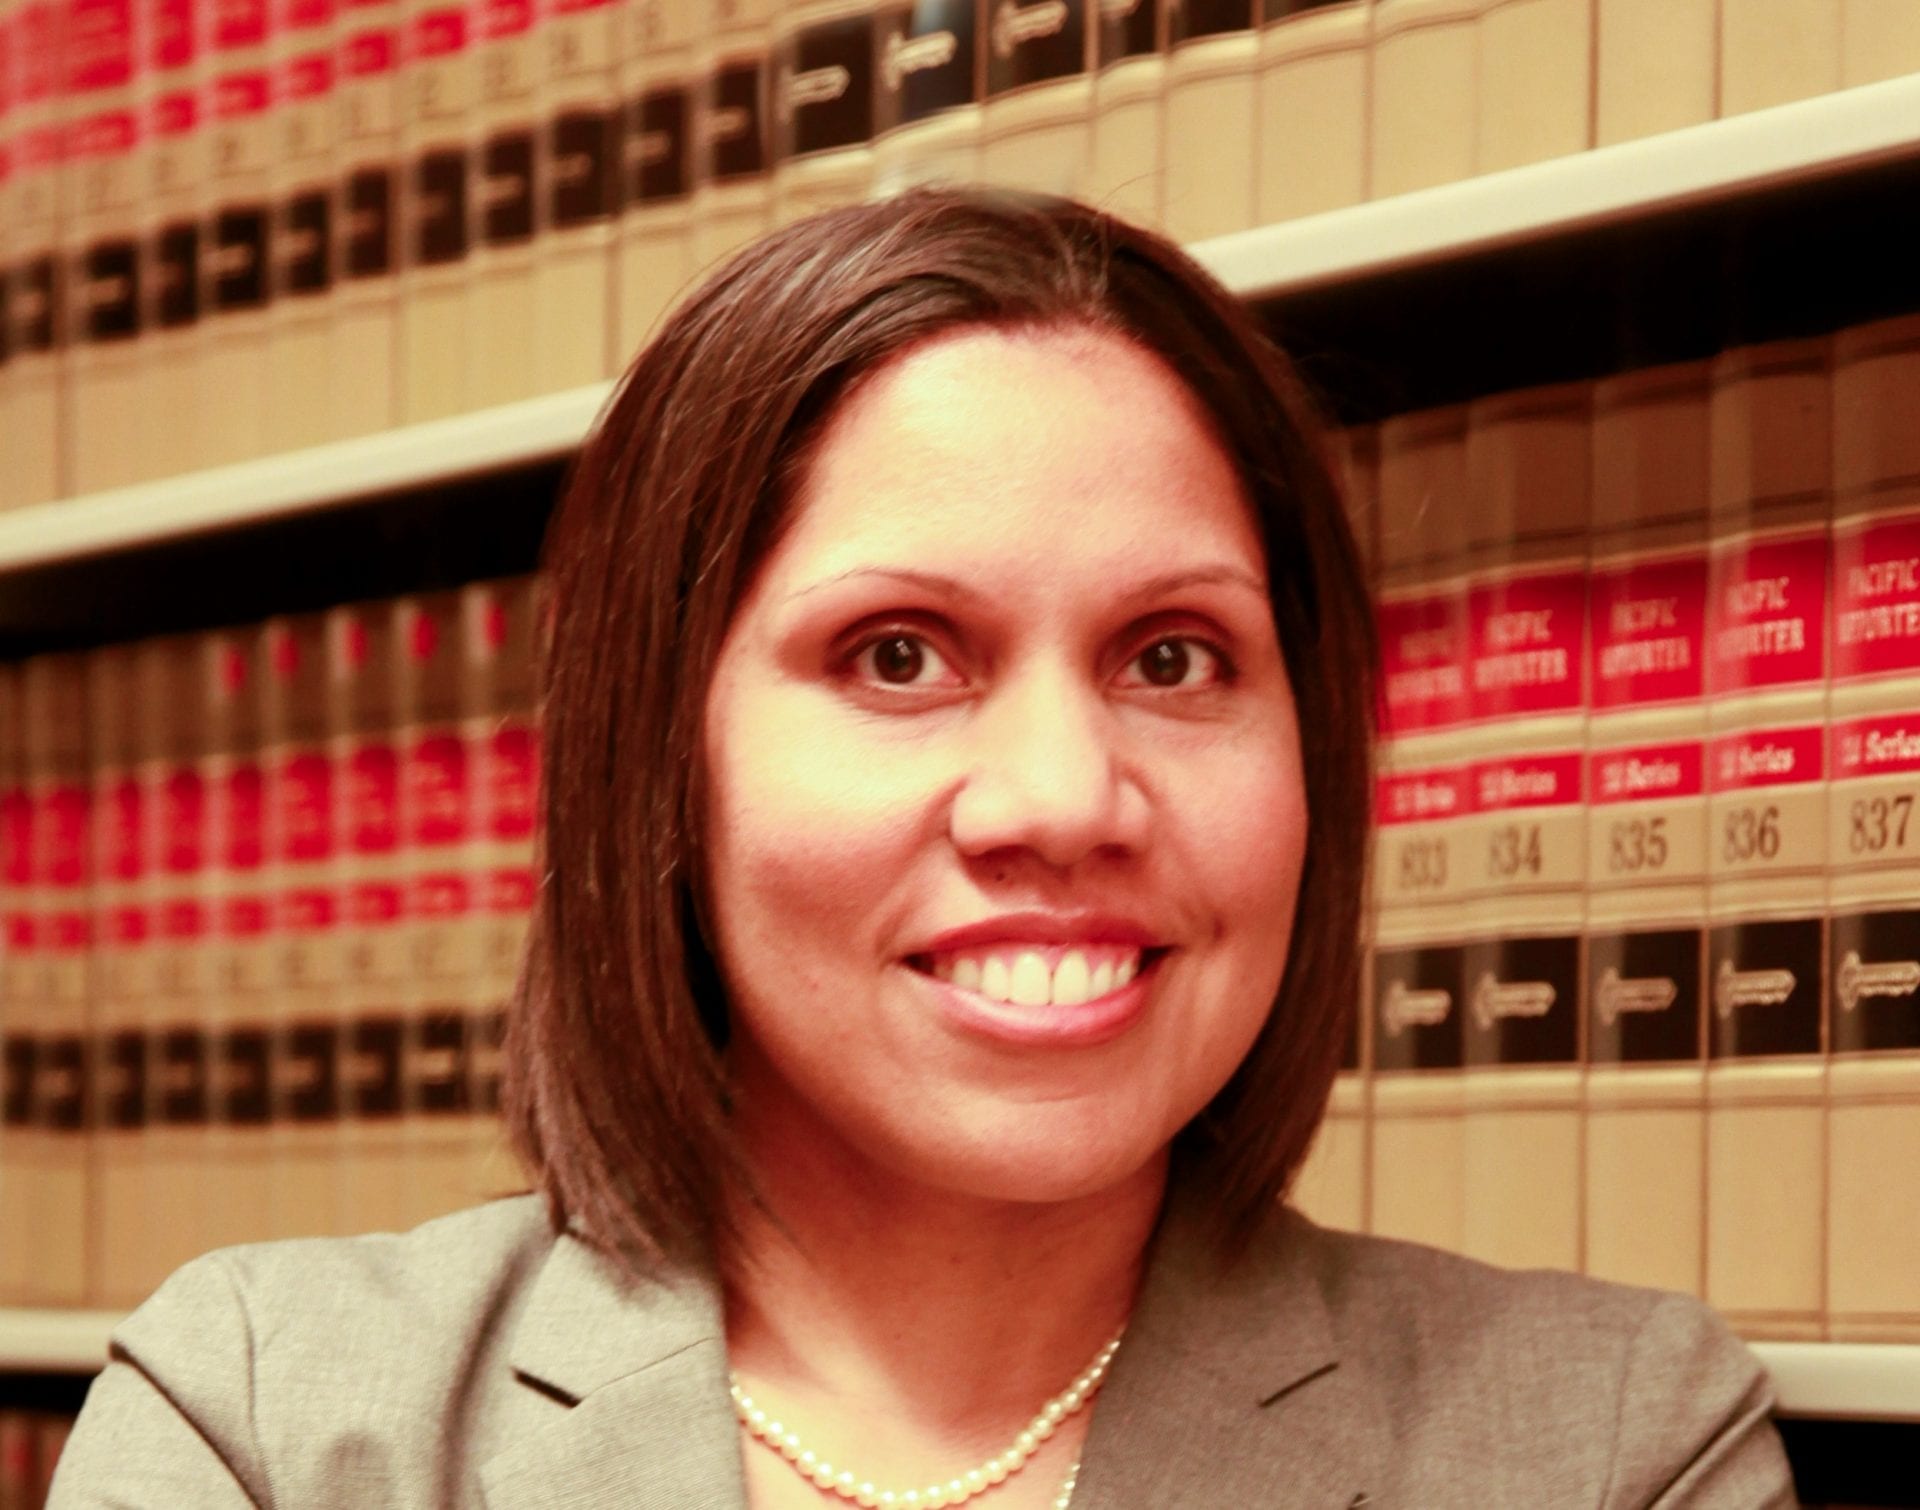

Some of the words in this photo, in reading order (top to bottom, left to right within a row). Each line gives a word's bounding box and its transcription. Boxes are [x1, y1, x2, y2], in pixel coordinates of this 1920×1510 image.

[1609, 815, 1669, 873] 835
[1723, 805, 1781, 865] 836
[1847, 794, 1914, 855] 837
